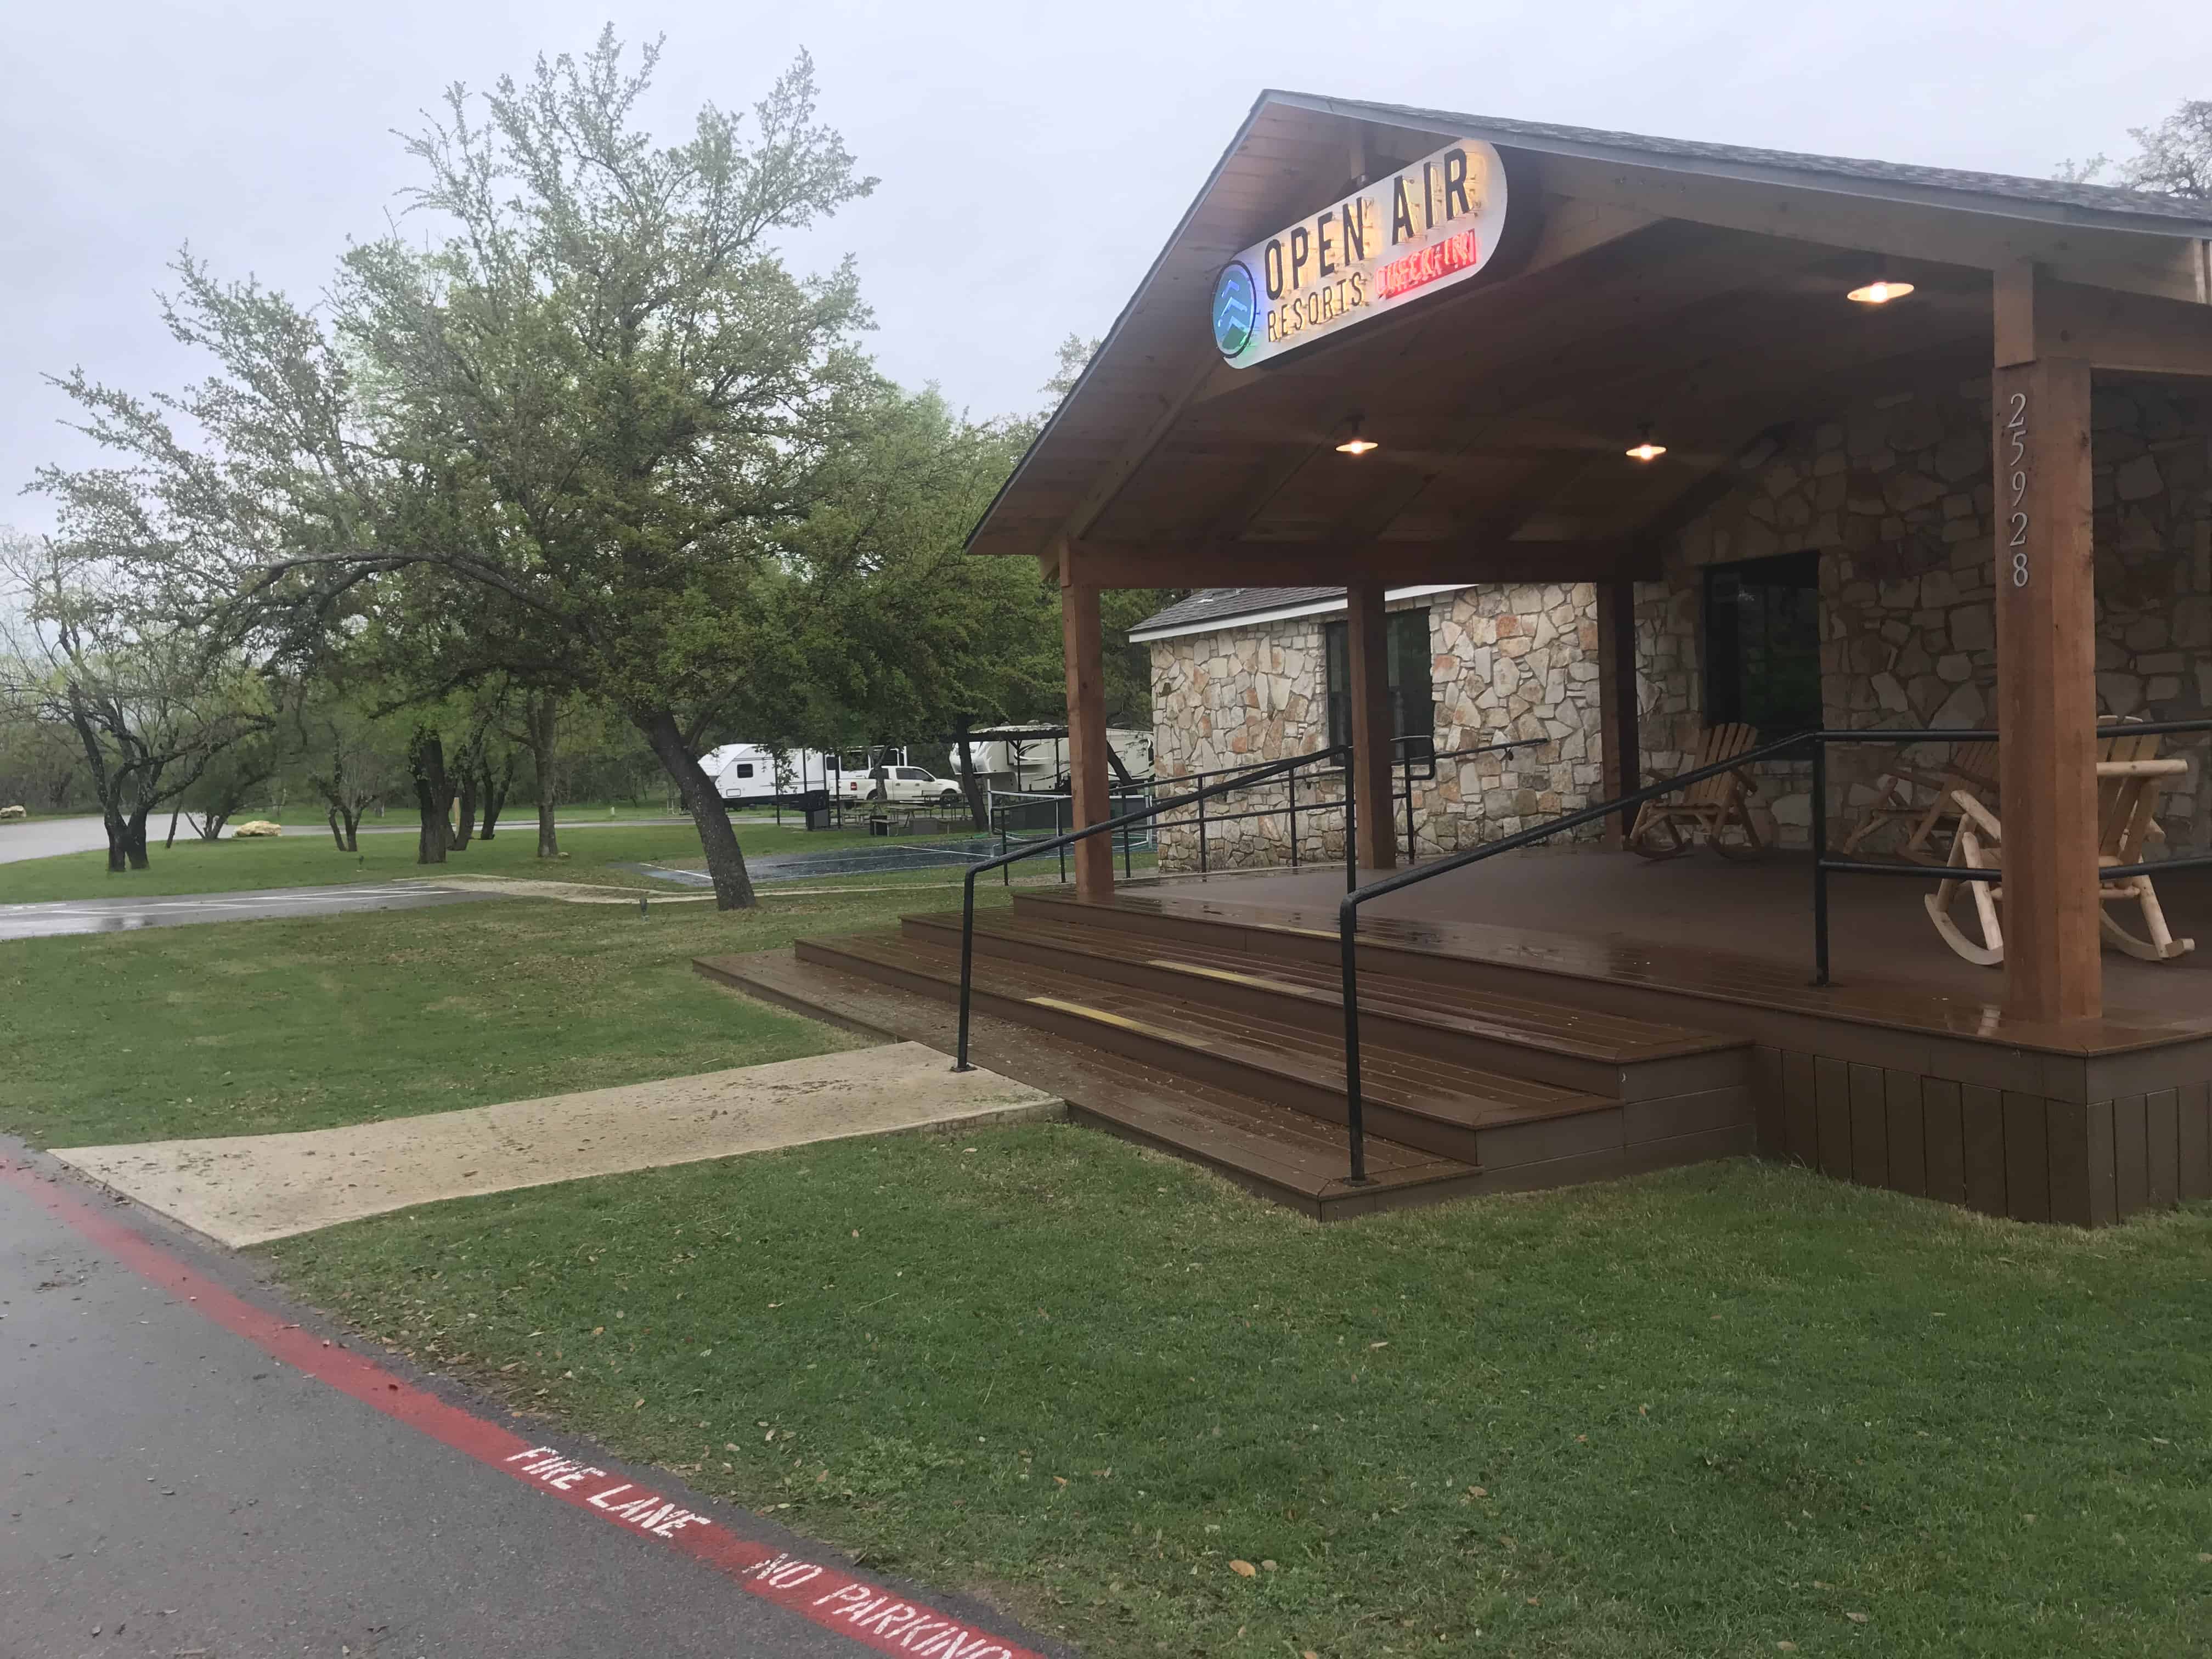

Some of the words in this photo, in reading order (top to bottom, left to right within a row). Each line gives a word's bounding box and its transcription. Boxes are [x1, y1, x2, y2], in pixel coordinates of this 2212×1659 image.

[1265, 196, 1365, 300] OPEN
[1392, 148, 1471, 245] AIR
[1375, 231, 1475, 295] CHECK-IN
[1267, 272, 1364, 342] RESORTS
[2007, 393, 2029, 588] 25928
[504, 1446, 607, 1491] FIRE
[585, 1483, 712, 1538] LANE
[741, 1553, 823, 1589] NO
